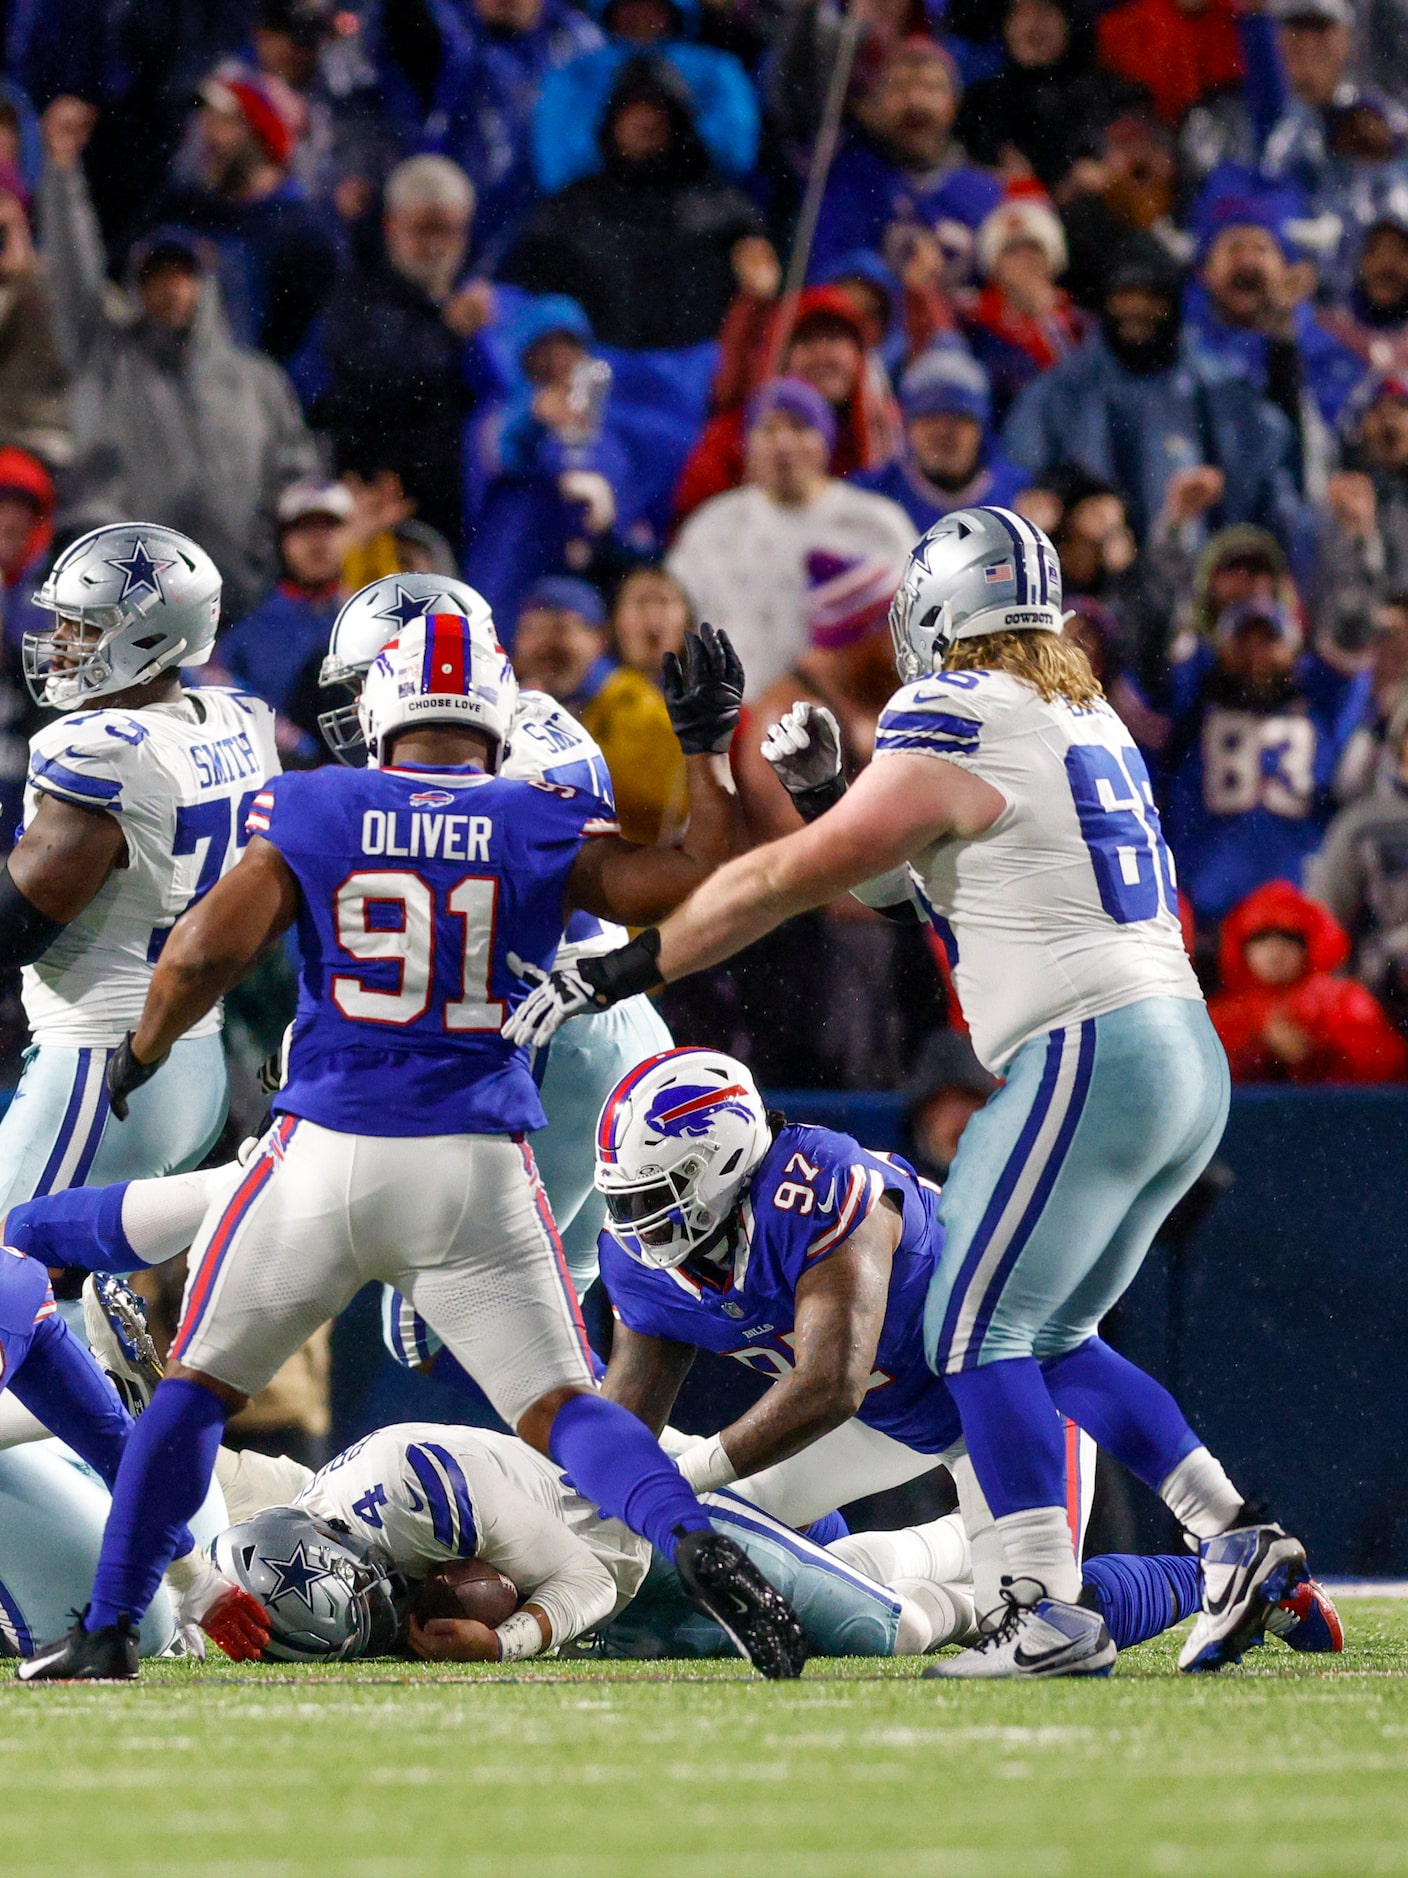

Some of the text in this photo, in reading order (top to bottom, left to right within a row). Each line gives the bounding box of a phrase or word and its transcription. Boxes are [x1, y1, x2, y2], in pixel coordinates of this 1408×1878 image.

[409, 699, 482, 713] CHOOSE LOVE
[190, 732, 261, 789] SMITH
[1201, 707, 1316, 818] 83
[361, 809, 492, 862] OLIVER
[331, 869, 509, 1033] 91
[773, 1152, 821, 1216] 97
[741, 1323, 775, 1339] BILLS
[351, 1483, 388, 1529] 4
